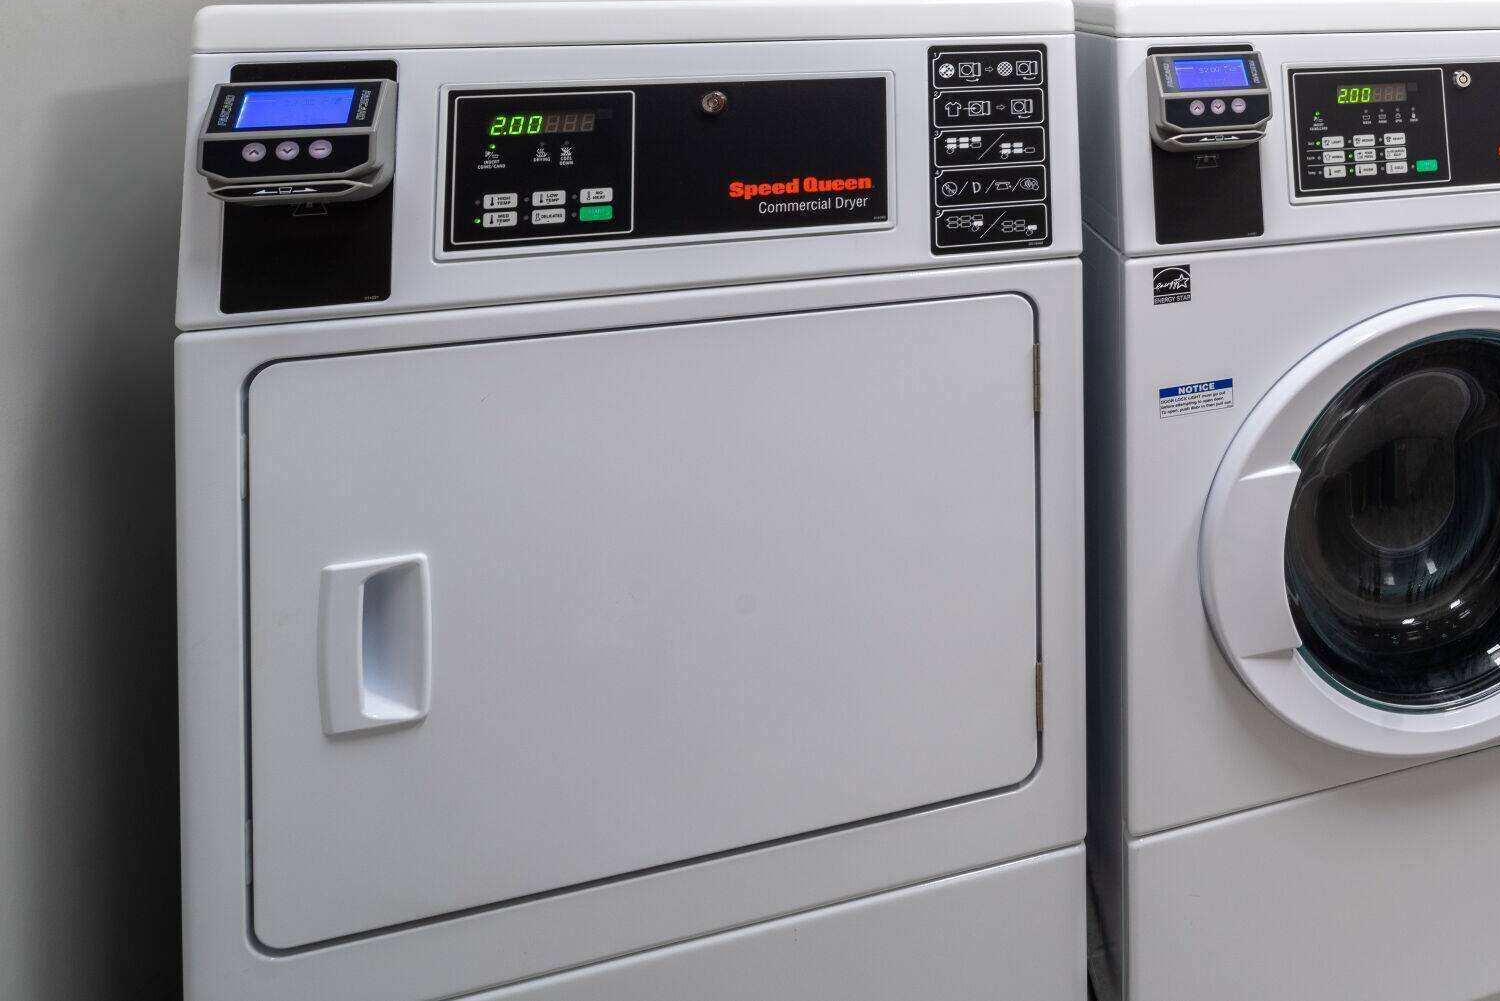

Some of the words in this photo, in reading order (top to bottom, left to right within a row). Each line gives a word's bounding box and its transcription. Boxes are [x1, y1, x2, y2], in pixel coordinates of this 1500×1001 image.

[1338, 88, 1371, 104] 2.00
[490, 115, 543, 135] 2.00
[728, 178, 799, 200] Speed
[803, 176, 872, 192] Queen
[758, 198, 830, 214] Commercial
[835, 196, 868, 210] Dryer
[1154, 296, 1175, 304] ENERGY
[1178, 382, 1215, 394] NOTICE
